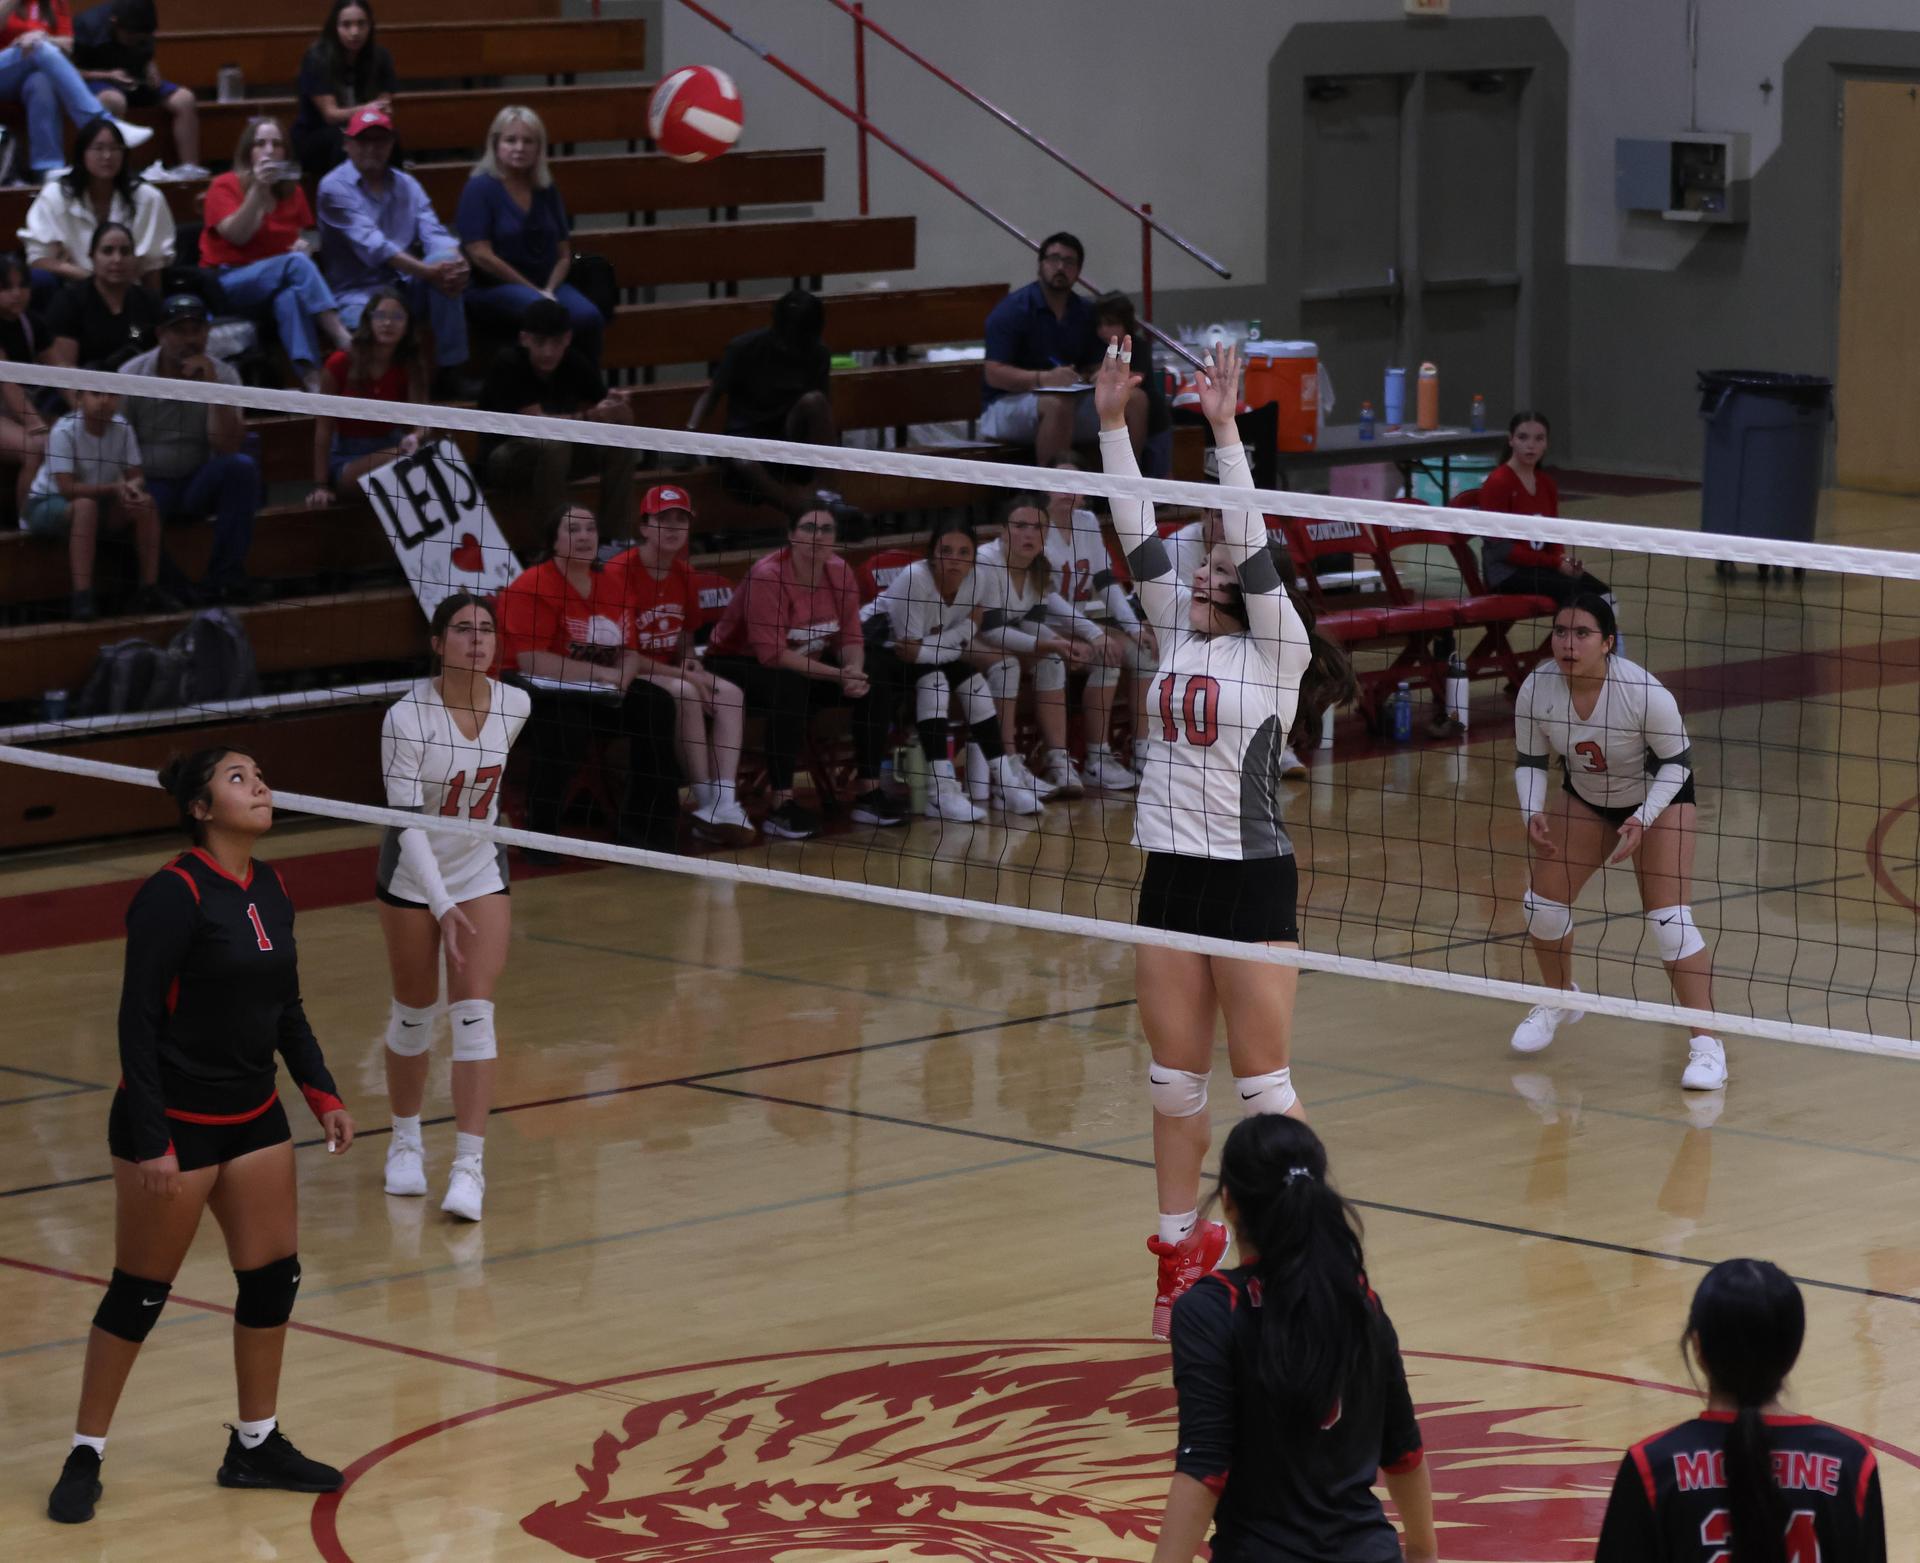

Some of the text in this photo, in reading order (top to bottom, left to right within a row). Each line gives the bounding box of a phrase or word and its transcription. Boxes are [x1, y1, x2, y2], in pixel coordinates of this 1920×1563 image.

[369, 437, 477, 550] LETS
[1060, 559, 1091, 601] 12
[1159, 673, 1221, 747] 10
[1574, 741, 1608, 772] 3
[440, 764, 501, 819] 17
[246, 903, 273, 951] 1
